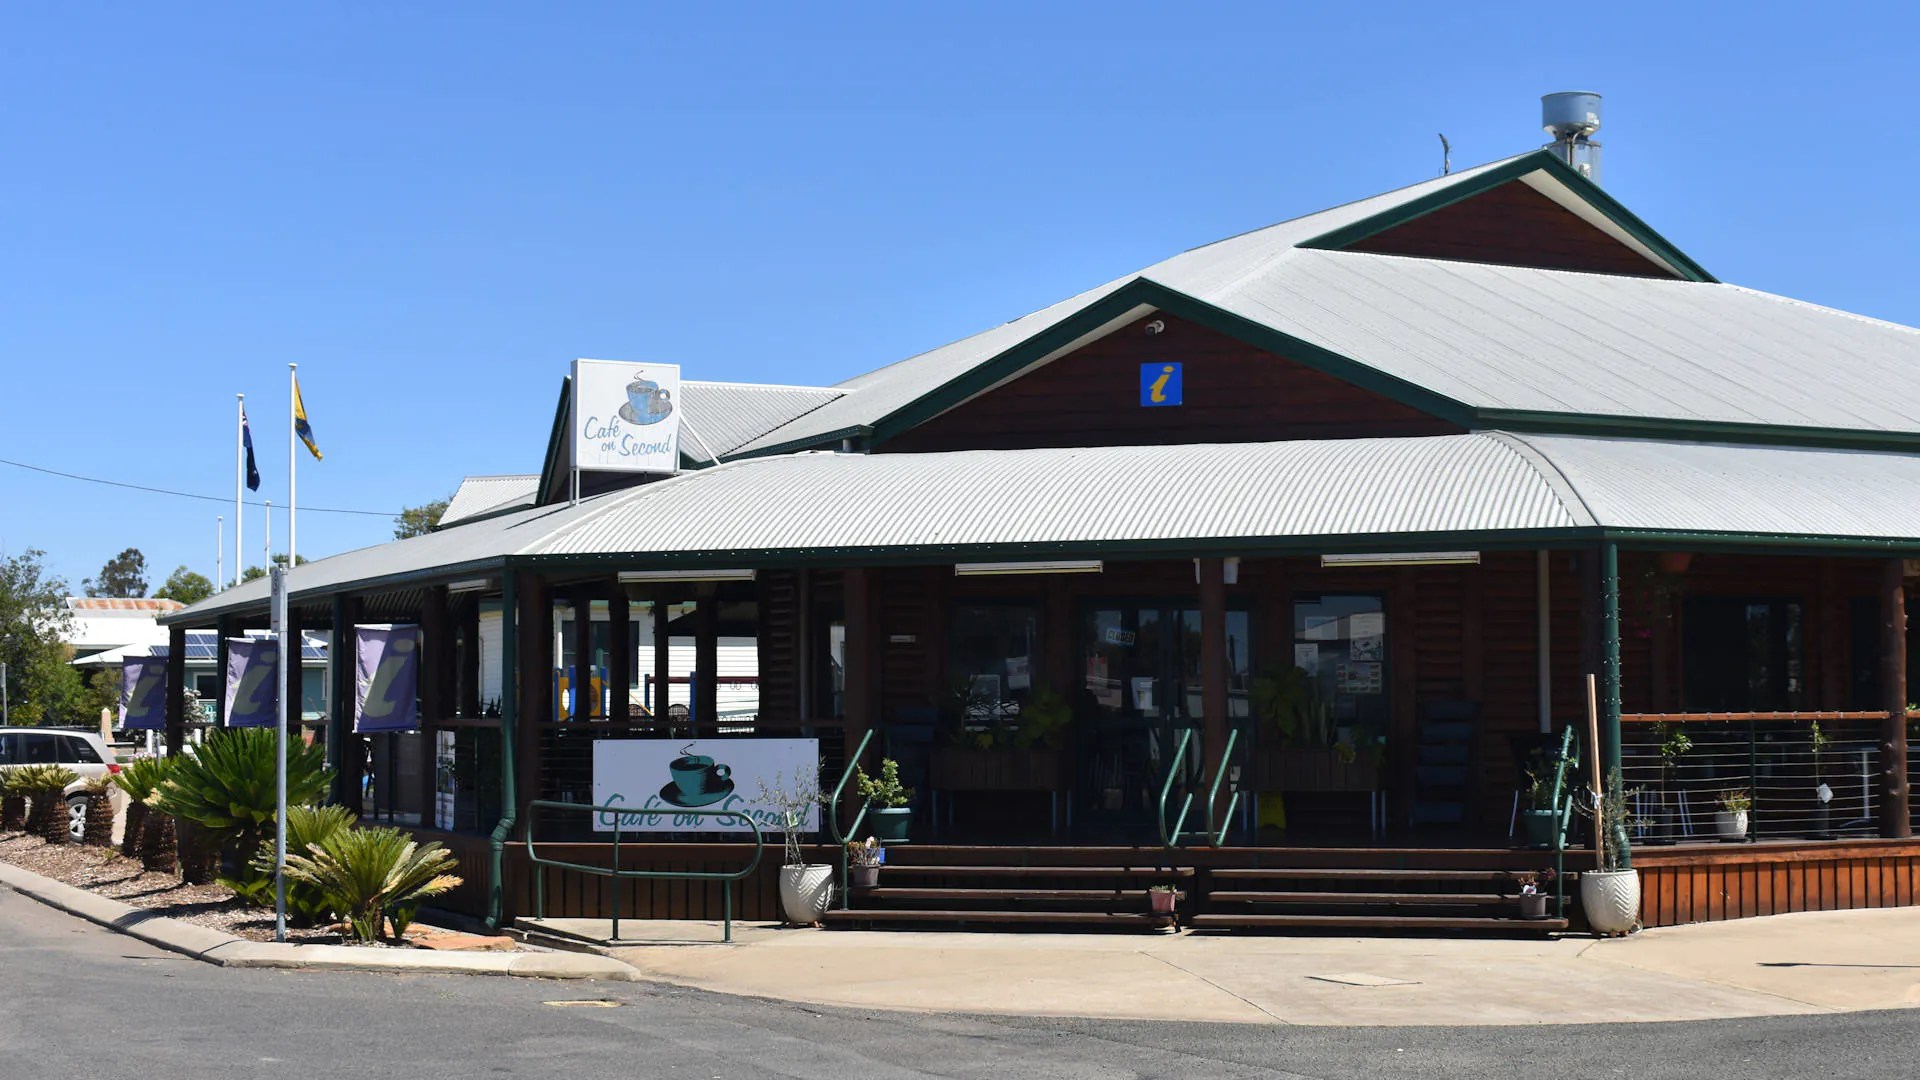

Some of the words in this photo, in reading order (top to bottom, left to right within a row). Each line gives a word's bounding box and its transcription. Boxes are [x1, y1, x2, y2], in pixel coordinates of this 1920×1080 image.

[1149, 365, 1175, 403] i
[584, 415, 621, 440] Café
[601, 441, 616, 452] on
[618, 433, 672, 457] Second
[599, 792, 662, 827] Café
[672, 807, 705, 827] on
